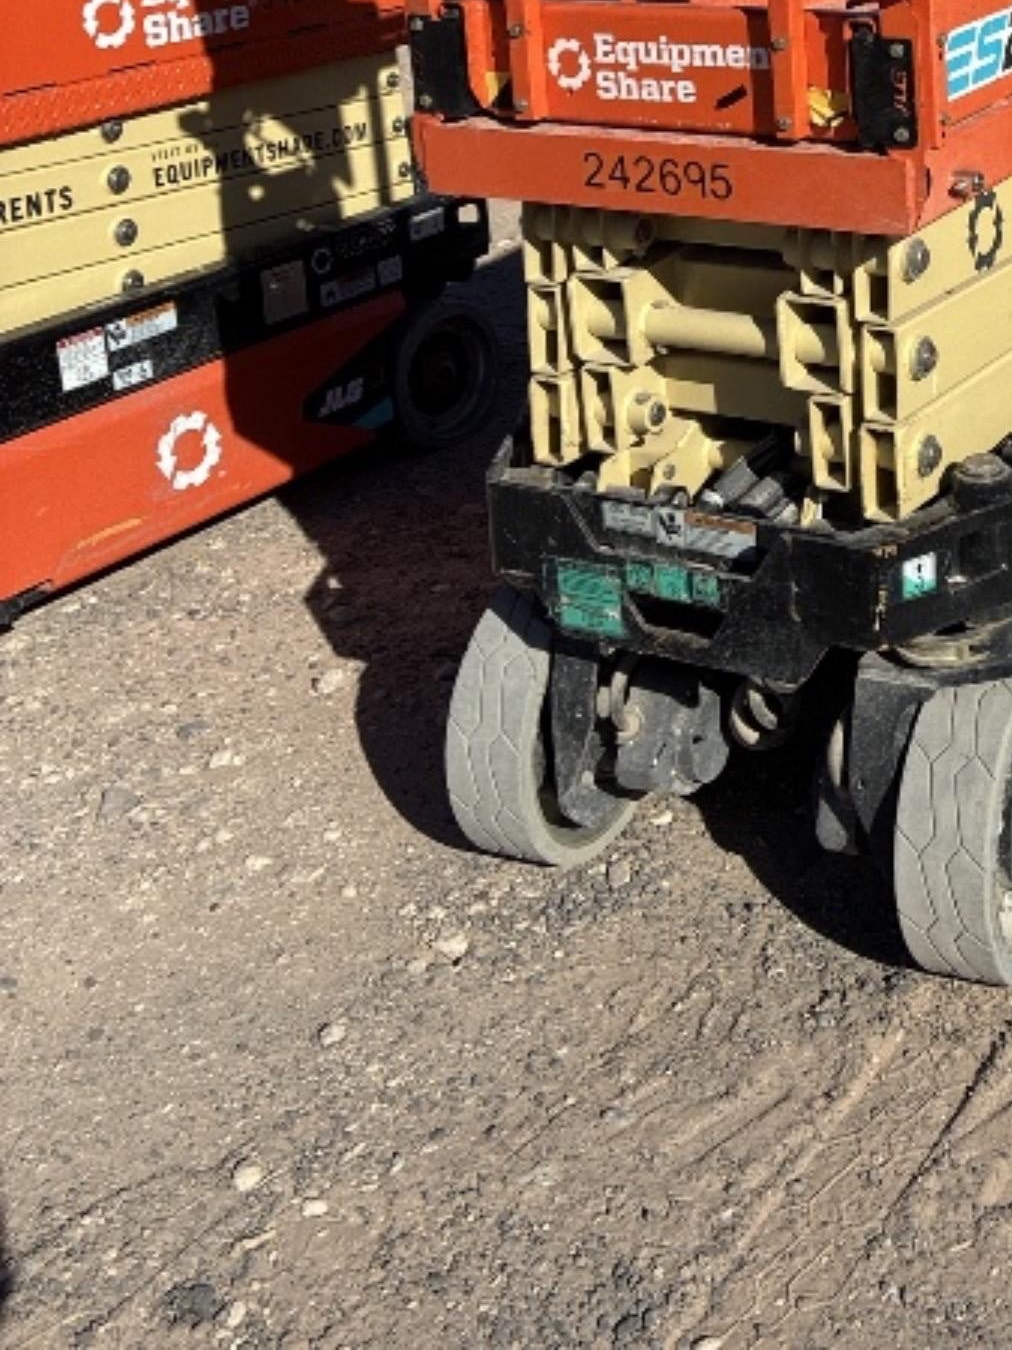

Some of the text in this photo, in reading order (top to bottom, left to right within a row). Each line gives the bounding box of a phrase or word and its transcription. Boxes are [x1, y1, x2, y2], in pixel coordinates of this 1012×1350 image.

[143, 4, 250, 49] Share
[593, 32, 770, 74] Equipmen
[596, 70, 698, 103] Share
[583, 152, 733, 200] 242695
